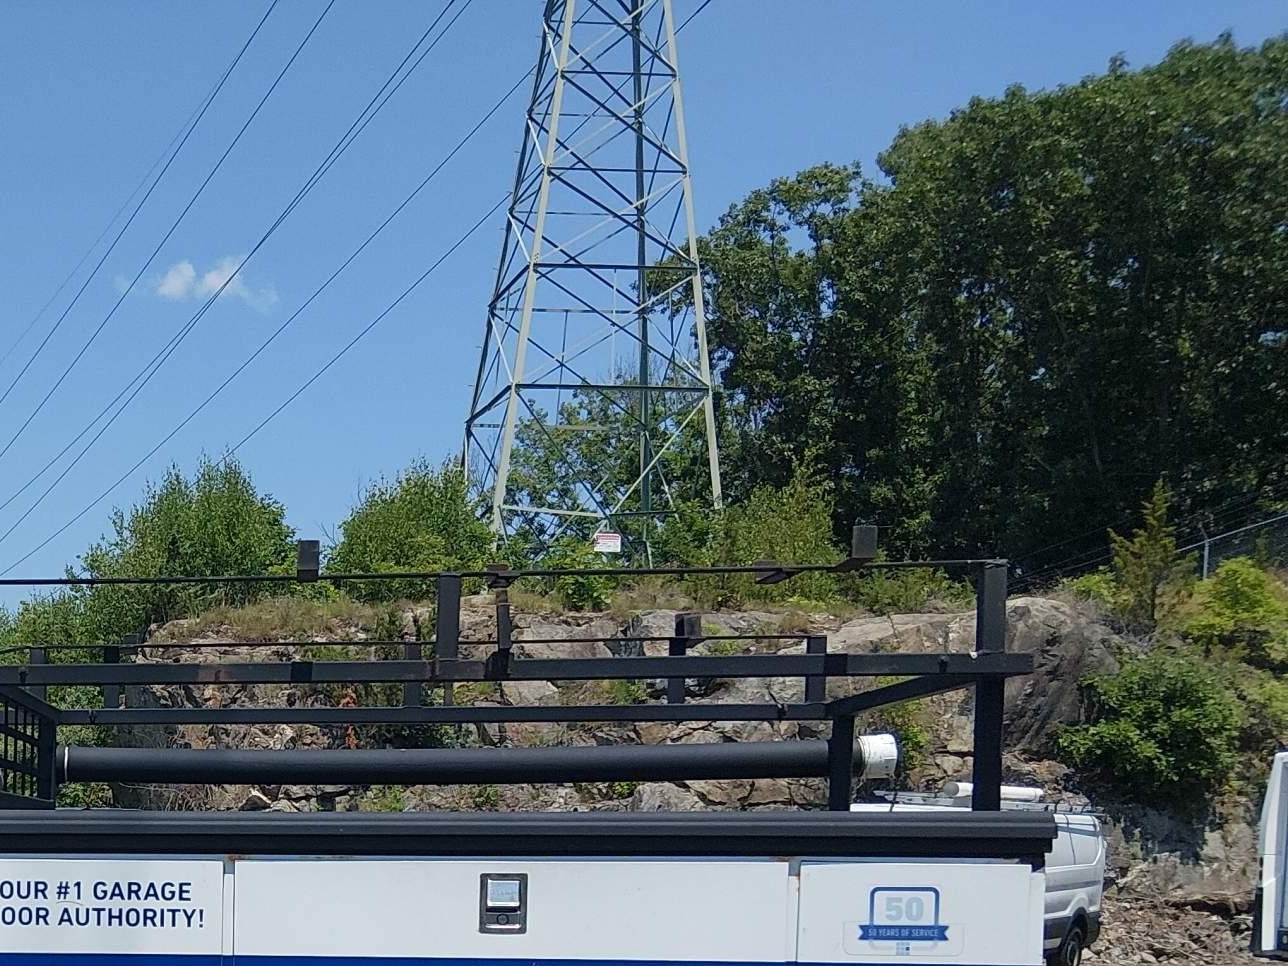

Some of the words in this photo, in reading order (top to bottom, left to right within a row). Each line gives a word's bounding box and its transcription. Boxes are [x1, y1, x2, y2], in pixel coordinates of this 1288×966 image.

[56, 881, 82, 902] #1
[93, 881, 192, 902] GARAGE
[58, 907, 205, 929] AUTHORITY!
[885, 896, 924, 921] 50
[879, 928, 899, 937] YEARS
[911, 928, 938, 937] SERVICE
